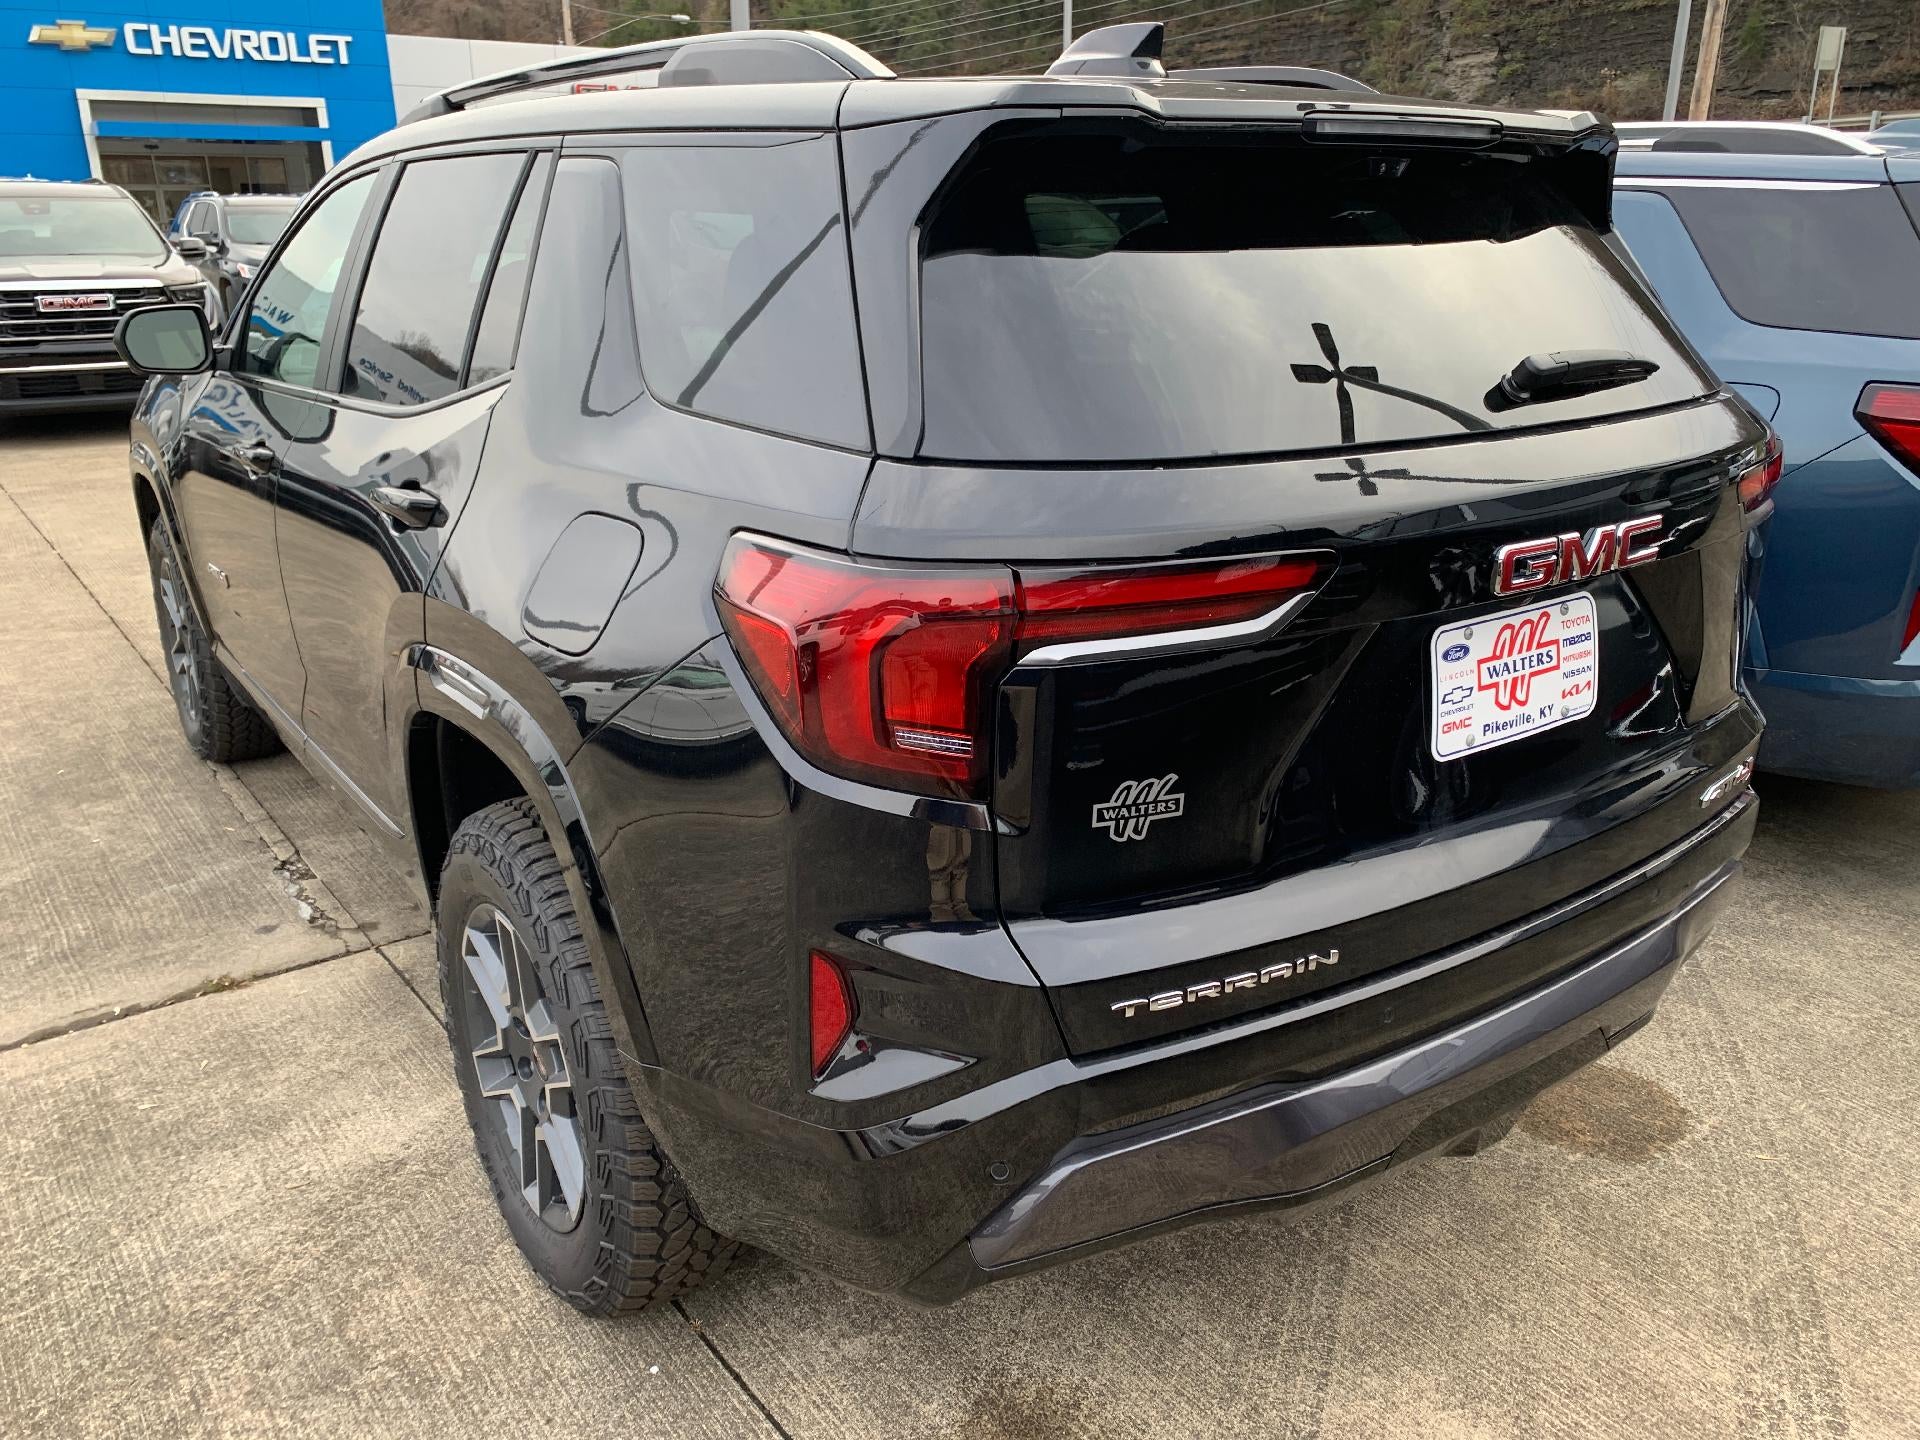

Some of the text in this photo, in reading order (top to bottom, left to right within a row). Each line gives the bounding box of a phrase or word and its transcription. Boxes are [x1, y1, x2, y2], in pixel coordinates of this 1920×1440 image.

[123, 22, 353, 65] CHEVROLET
[42, 296, 110, 309] GMC
[1493, 514, 1663, 596] GMC
[1561, 614, 1591, 630] TOYOTA
[1486, 649, 1554, 680] WALTERS
[1562, 649, 1593, 664] MITSUBISHI
[1440, 669, 1475, 682] LINCOLN
[1562, 665, 1592, 680] NISSAN
[1440, 703, 1474, 718] CHEVROLET
[1482, 712, 1536, 737] Pikeville,
[1539, 703, 1554, 720] KY
[1441, 716, 1473, 735] GMC
[1102, 800, 1176, 820] WALTERS
[1110, 949, 1340, 1018] TERRAIN
